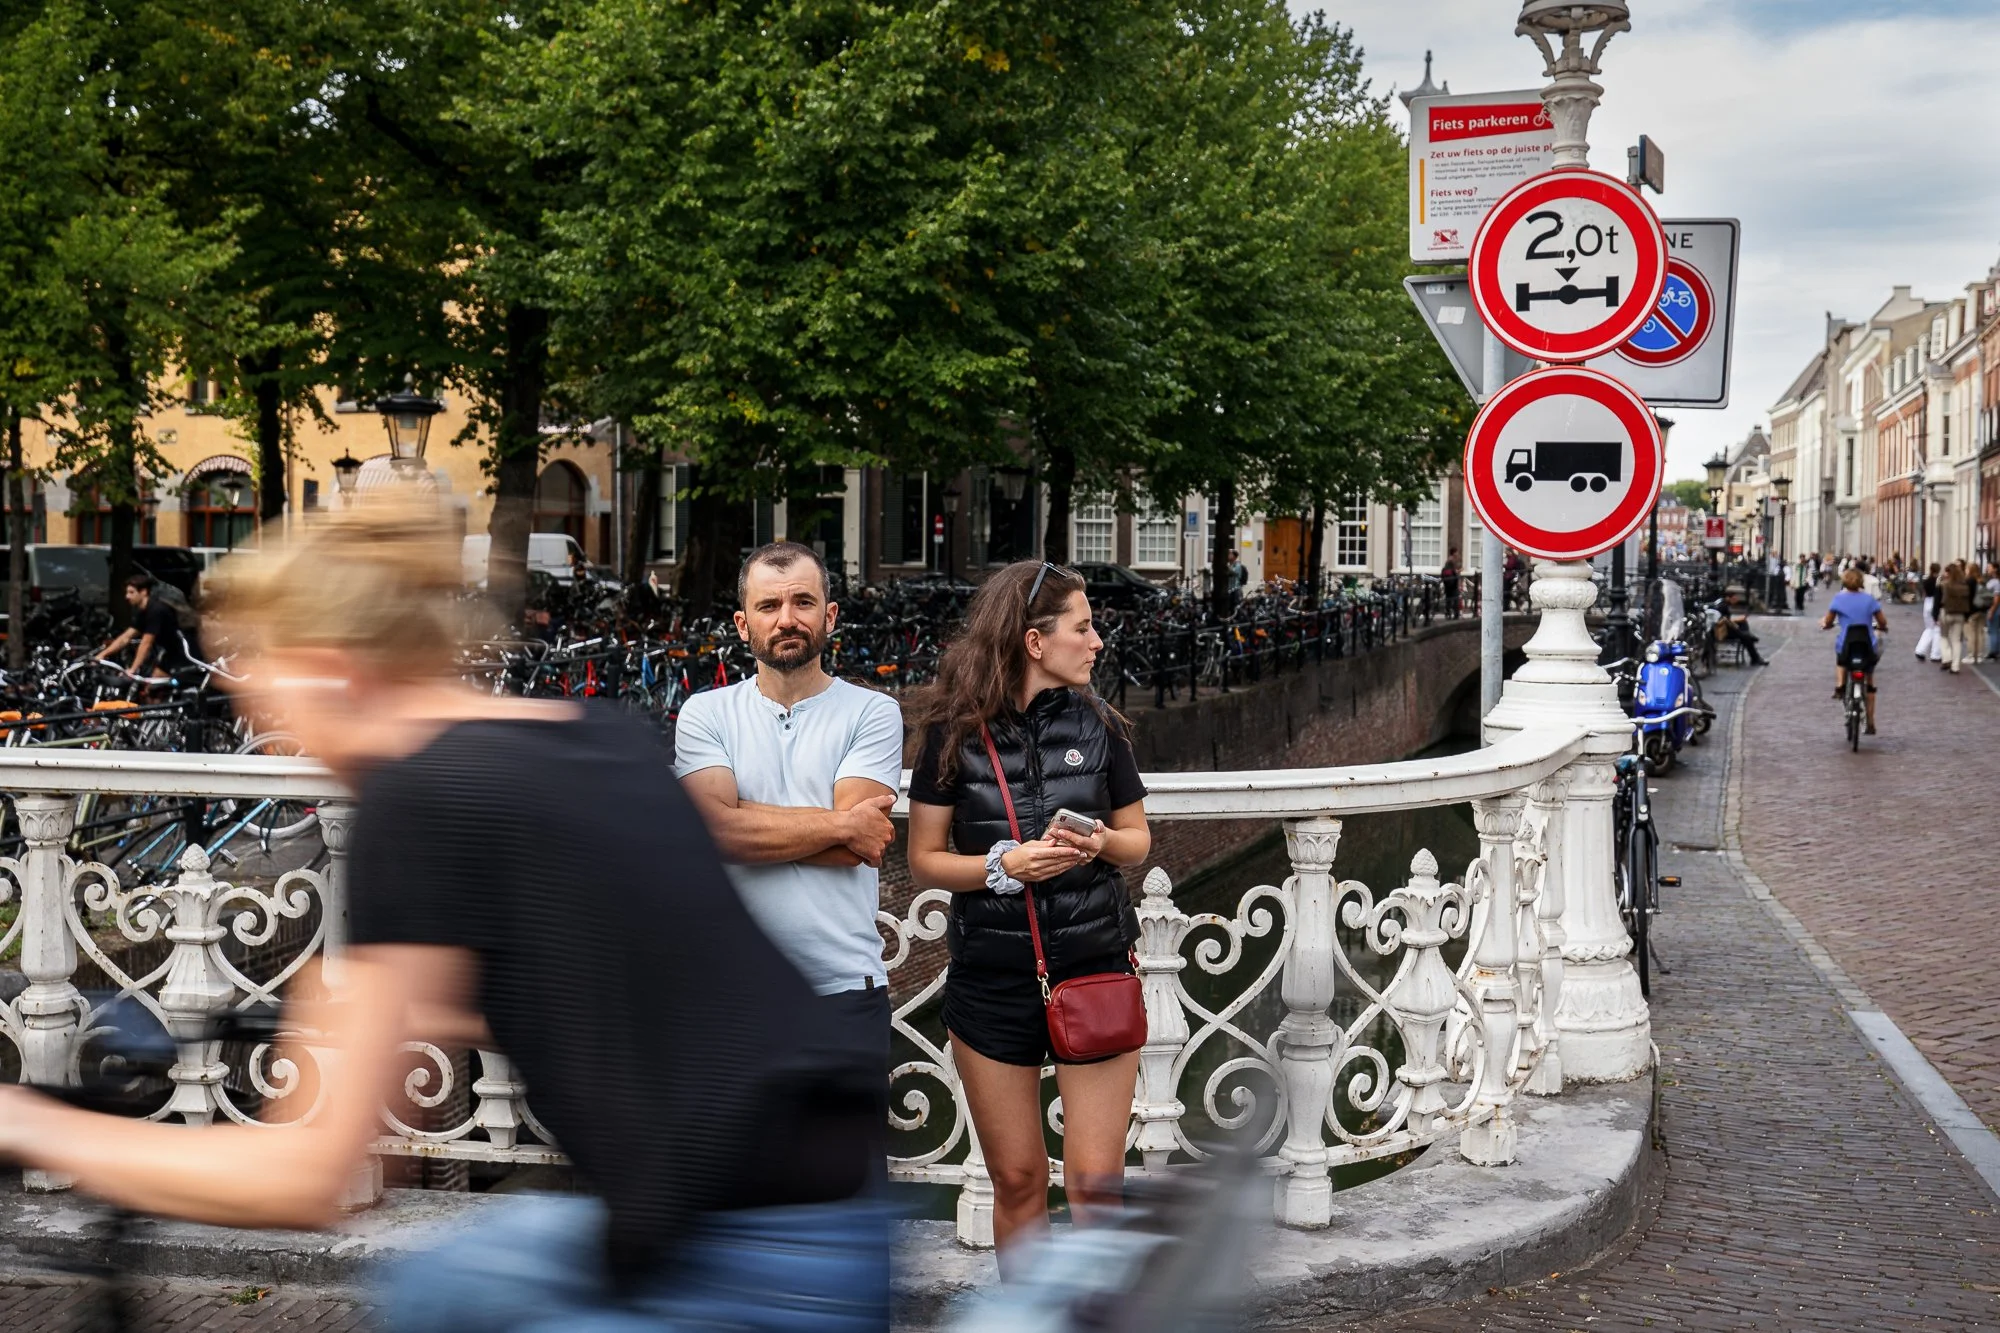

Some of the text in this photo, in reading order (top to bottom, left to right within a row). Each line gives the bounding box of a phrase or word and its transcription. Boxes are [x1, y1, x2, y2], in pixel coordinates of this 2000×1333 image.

[1433, 114, 1529, 131] Fiets parkeren
[1430, 151, 1445, 160] Zet
[1464, 148, 1484, 157] fiets
[1486, 147, 1499, 156] op
[1501, 145, 1513, 154] de
[1514, 144, 1541, 155] juiste
[1543, 143, 1553, 154] pl
[1430, 186, 1478, 197] Fiets weg?
[1525, 210, 1619, 263] 2,0t
[1664, 232, 1693, 248] NE
